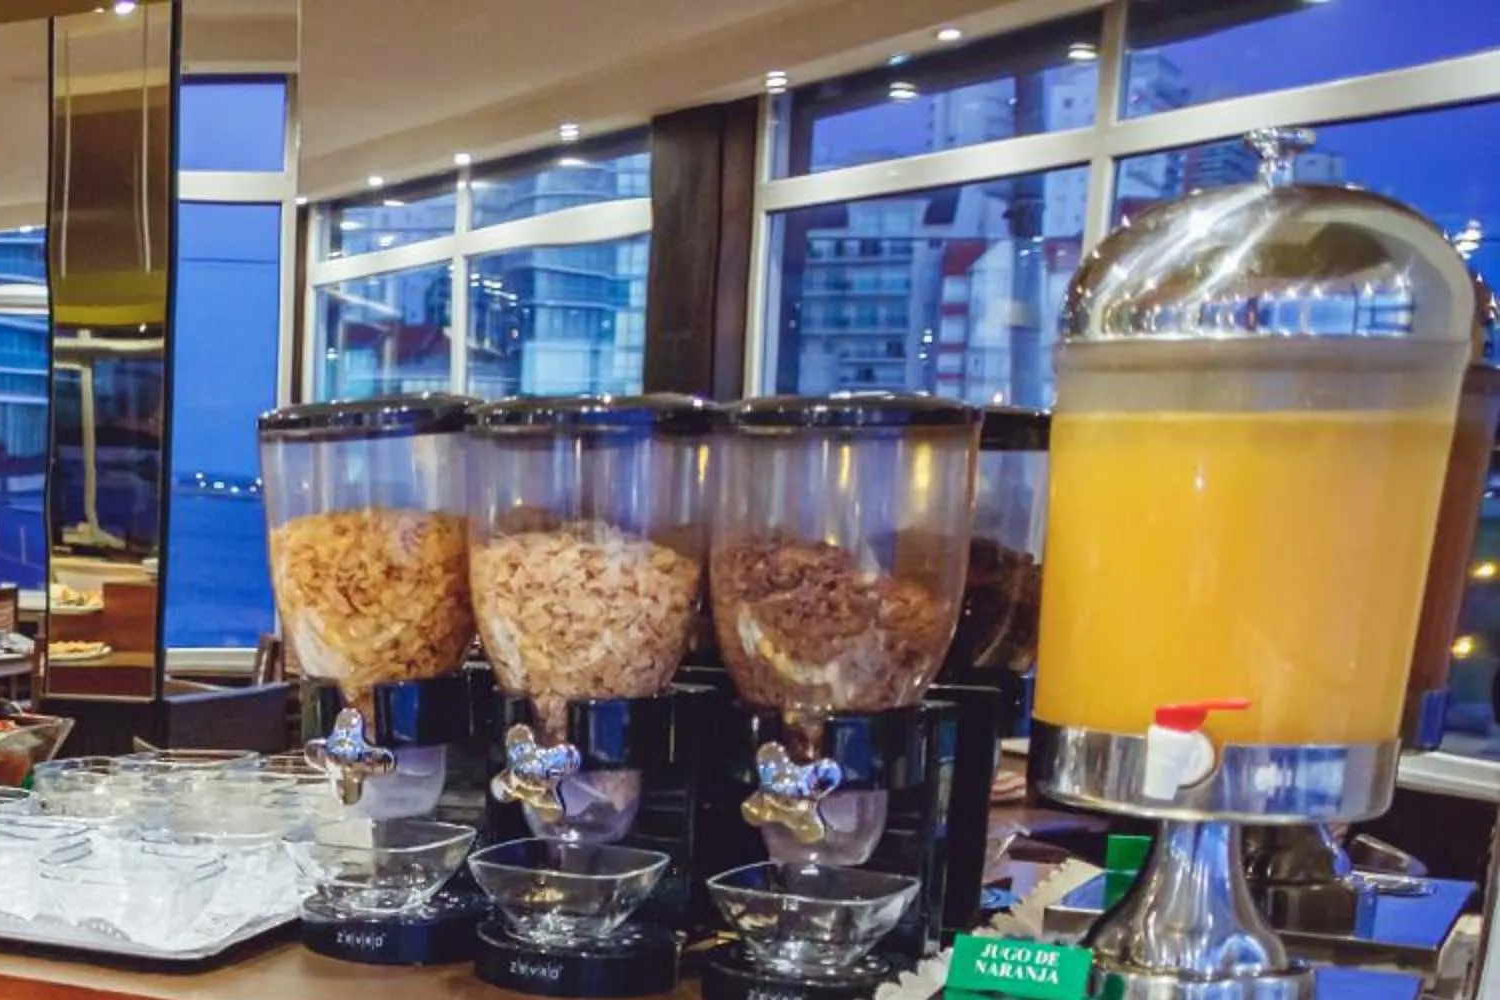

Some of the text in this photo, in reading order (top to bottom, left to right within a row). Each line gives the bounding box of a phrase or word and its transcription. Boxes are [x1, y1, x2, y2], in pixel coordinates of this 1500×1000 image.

[981, 943, 1060, 967] JUGO DE
[974, 959, 1060, 985] NARANJA
